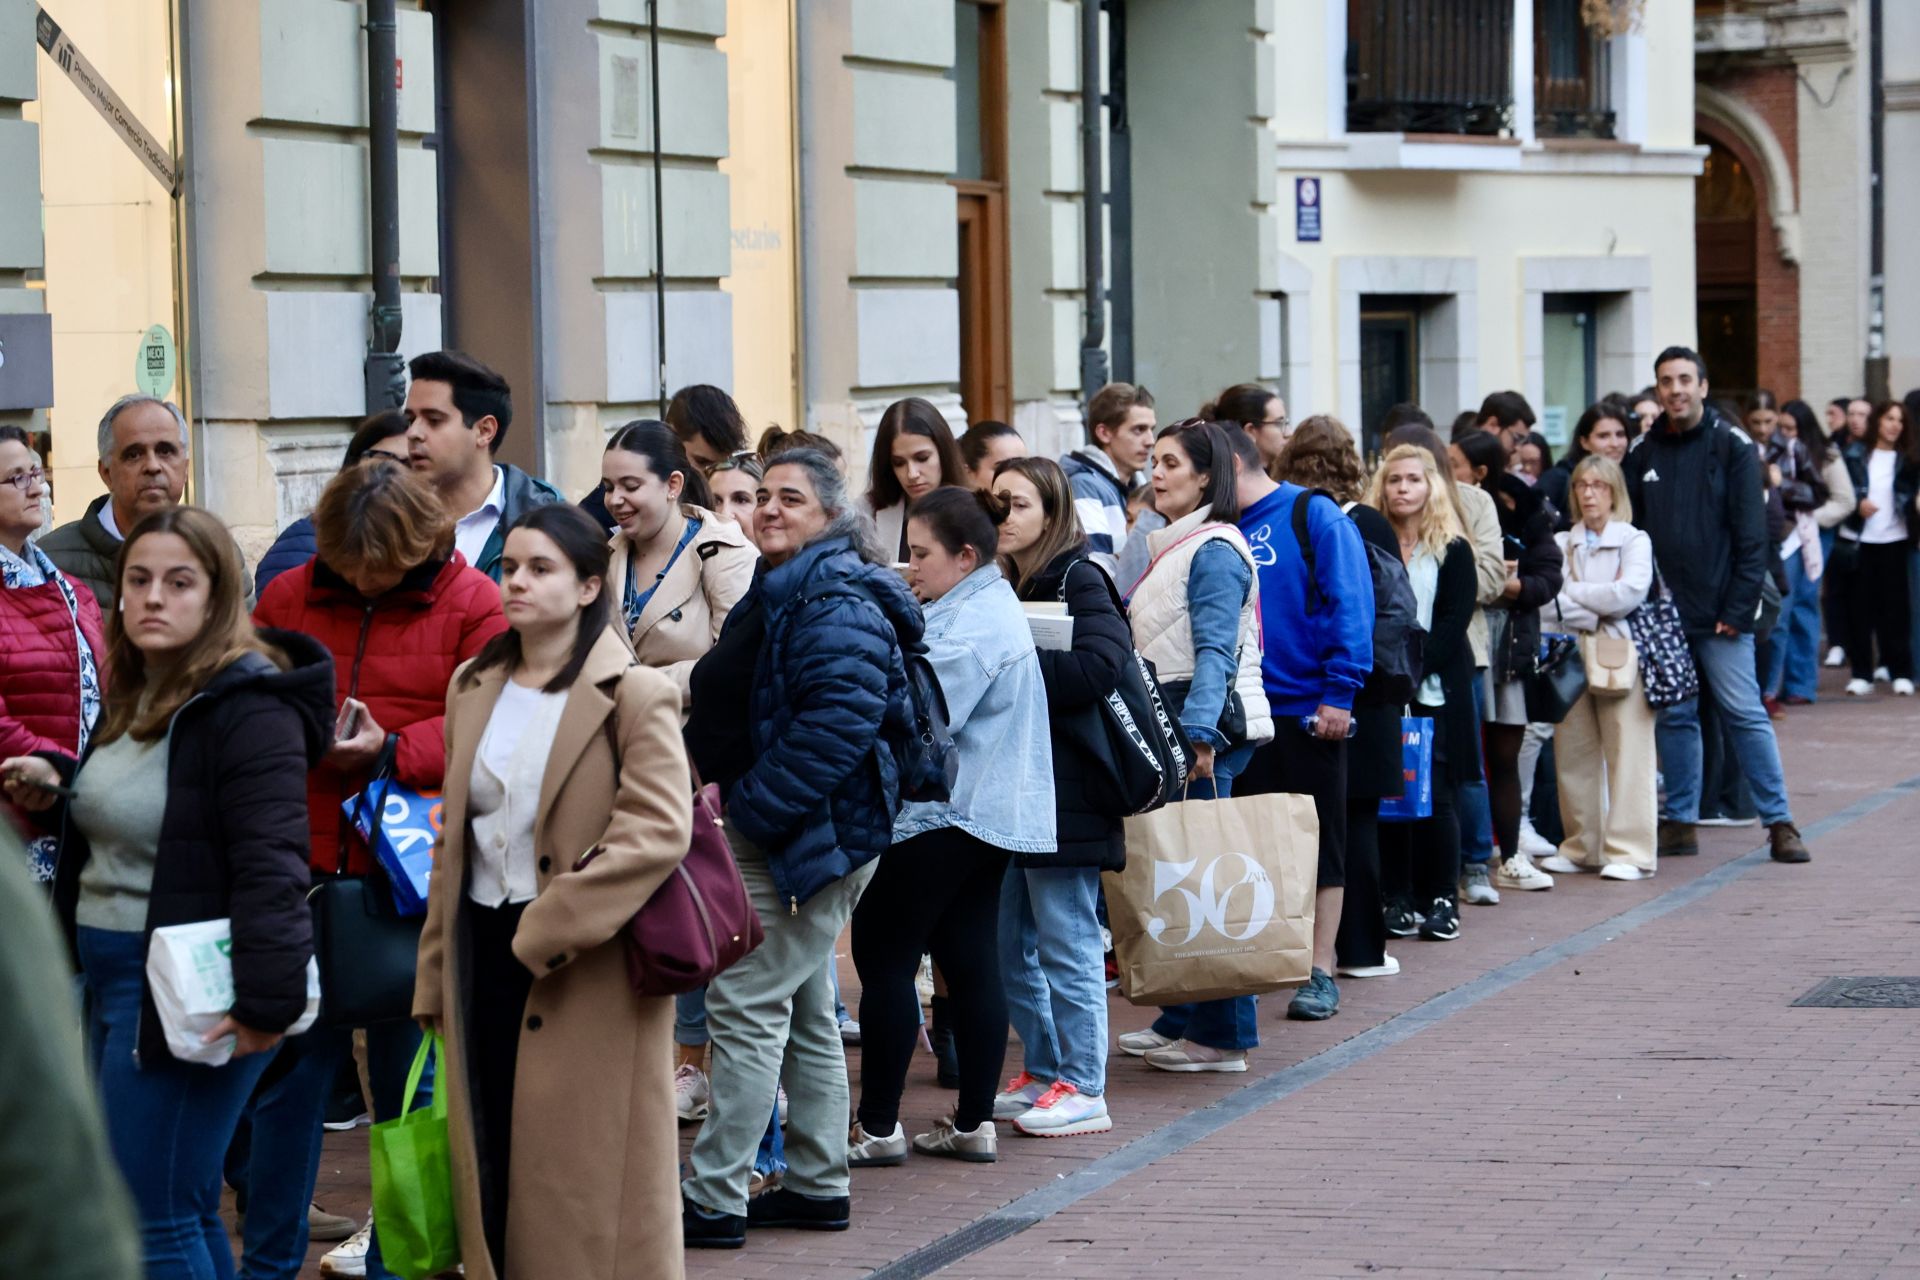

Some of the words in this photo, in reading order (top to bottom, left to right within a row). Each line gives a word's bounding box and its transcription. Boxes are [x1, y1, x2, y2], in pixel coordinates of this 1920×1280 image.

[73, 61, 97, 94] Premio
[96, 88, 114, 114] Mejor
[114, 108, 143, 148] Comercio
[143, 141, 175, 185] Tradicional
[1109, 691, 1137, 733] BIMBA
[1147, 851, 1275, 947] 50
